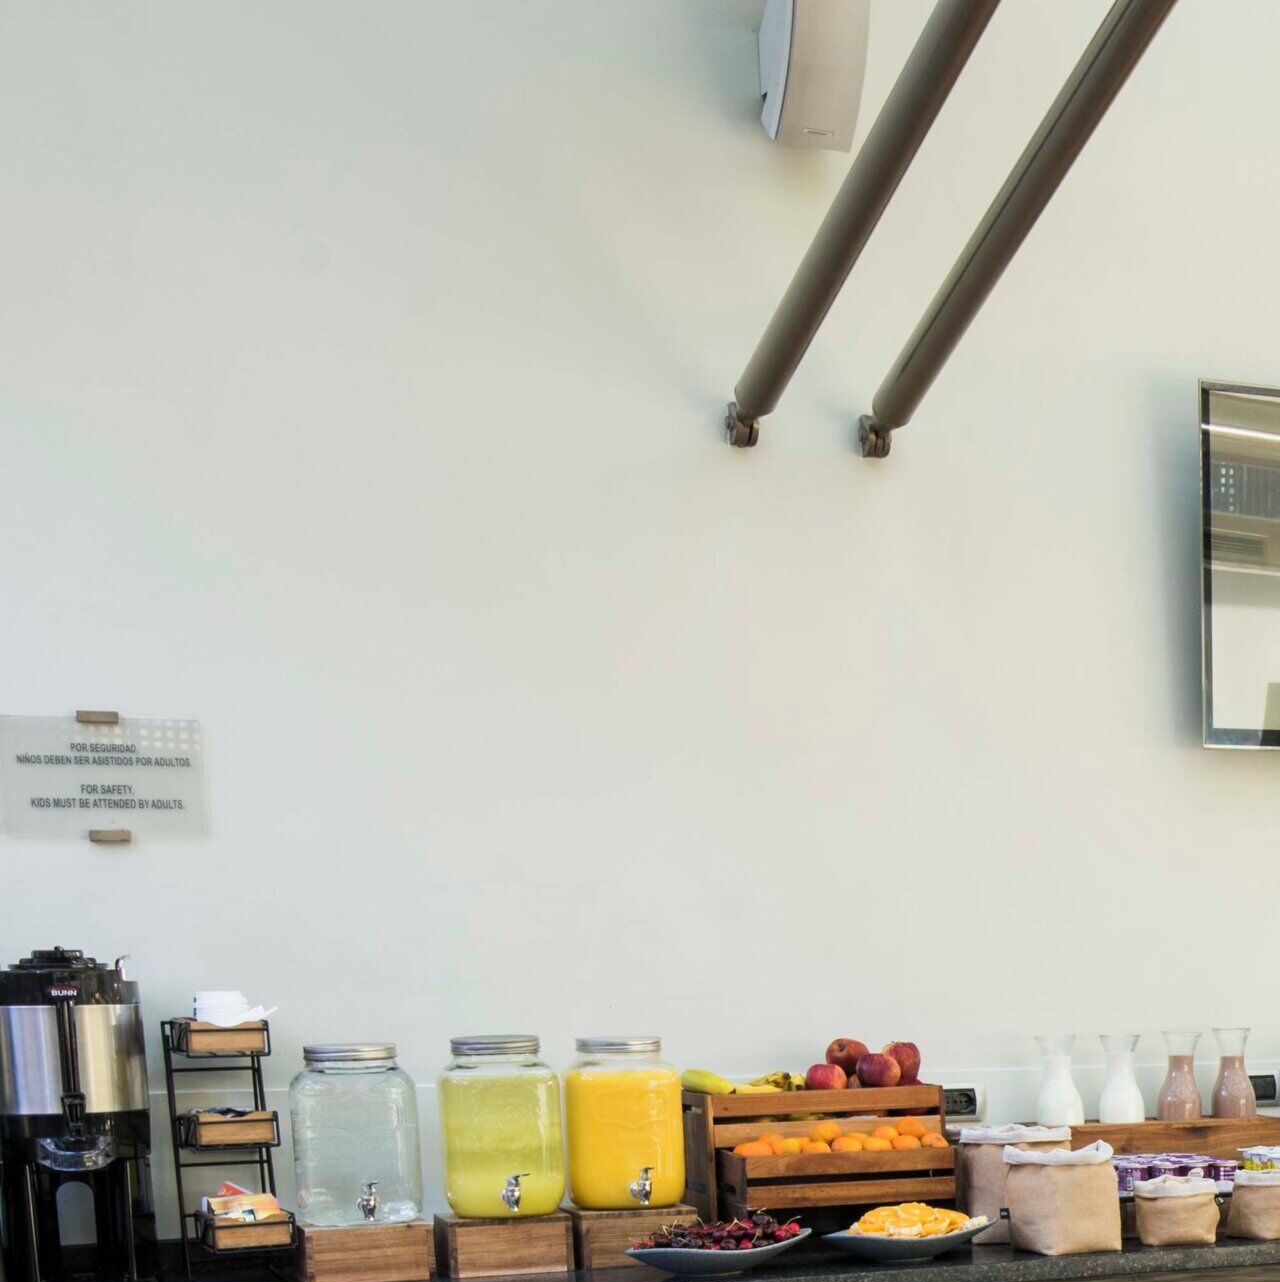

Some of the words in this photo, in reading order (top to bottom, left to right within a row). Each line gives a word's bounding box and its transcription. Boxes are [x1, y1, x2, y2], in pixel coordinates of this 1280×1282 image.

[70, 743, 88, 752] POR
[16, 753, 42, 764] NIÑOS
[44, 755, 72, 765] DEBEN
[74, 756, 90, 765] SER
[92, 756, 134, 766] ASISTIDOS
[136, 757, 152, 766] POR
[154, 757, 192, 767] ADULTOS.
[81, 784, 99, 794] FOR
[100, 784, 134, 796] SAFETY,
[31, 797, 51, 808] KIDS
[53, 798, 77, 808] MUST
[78, 798, 91, 808] BE
[92, 798, 136, 809] ATTENDED
[138, 799, 149, 809] BY
[151, 799, 186, 810] ADULTS.
